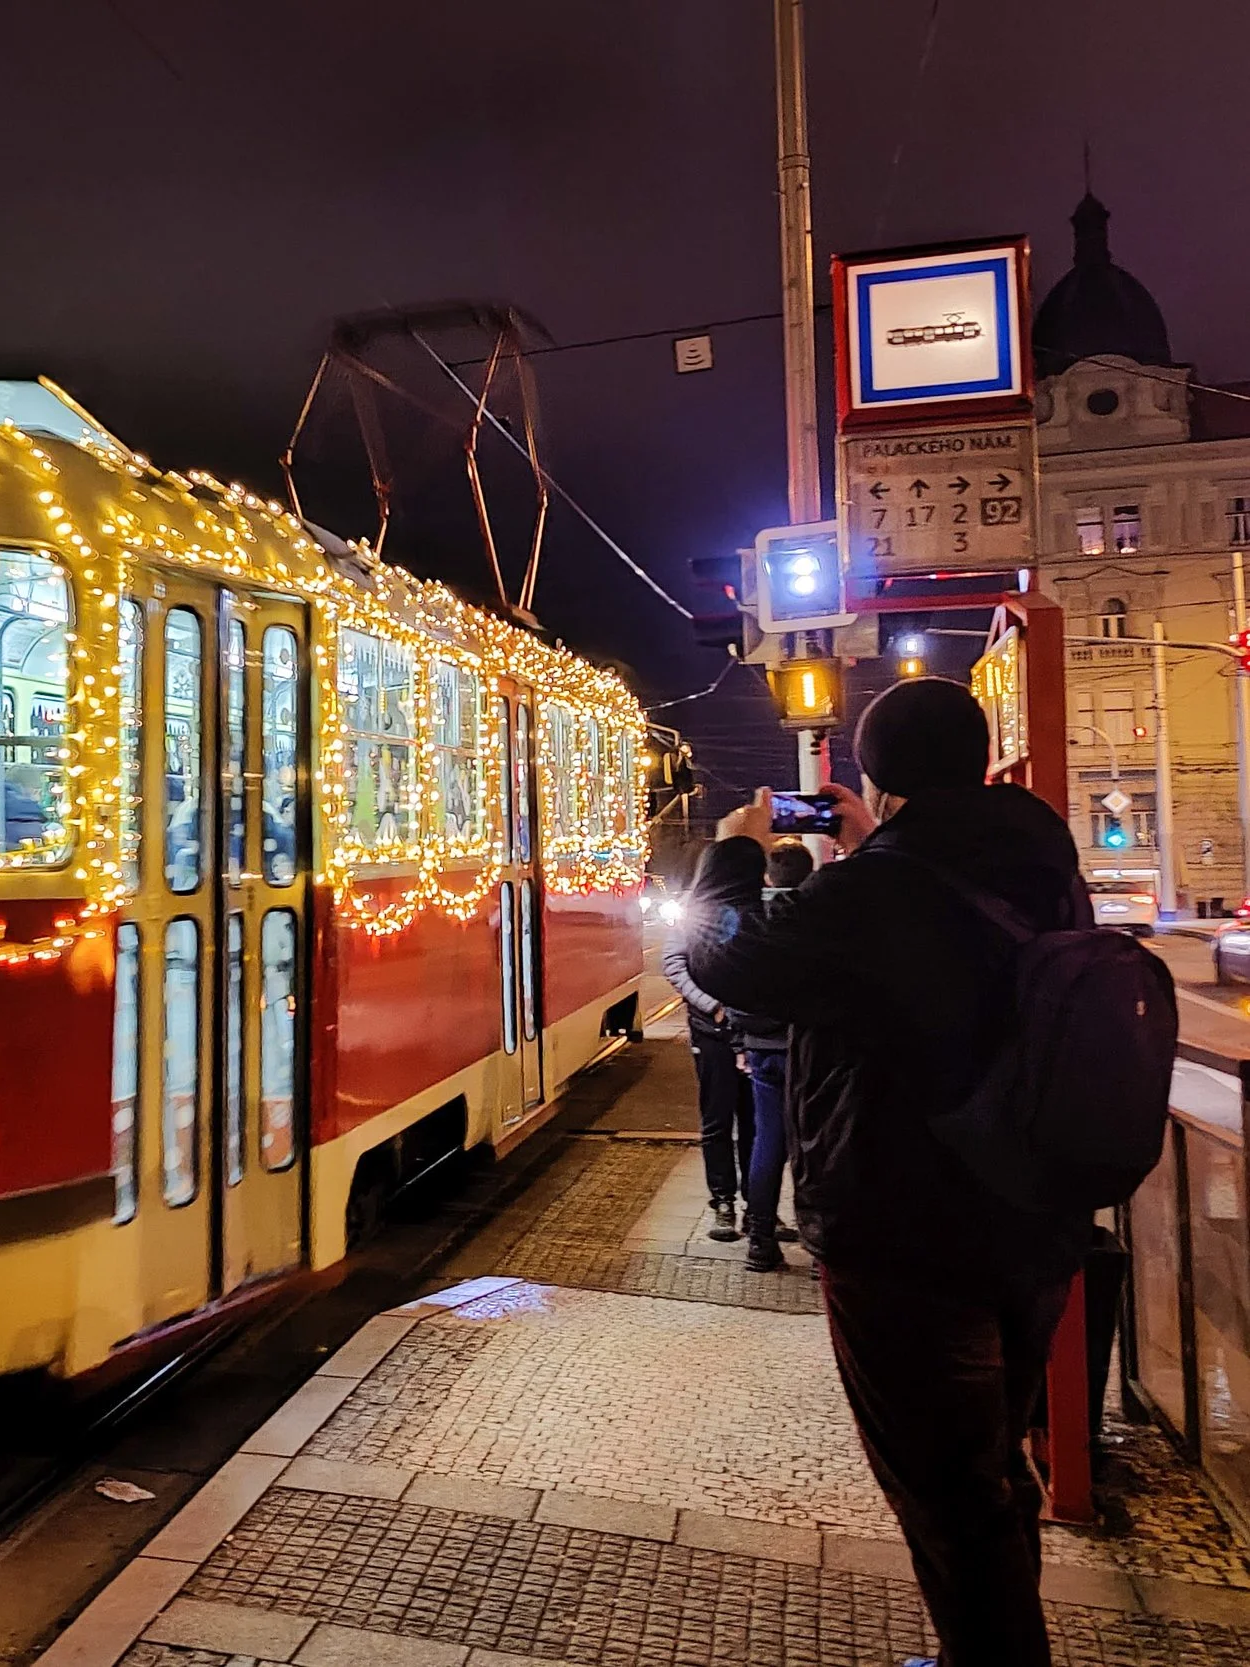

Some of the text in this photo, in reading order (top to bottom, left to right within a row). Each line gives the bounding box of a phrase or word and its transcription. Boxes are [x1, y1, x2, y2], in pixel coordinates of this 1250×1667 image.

[872, 500, 1019, 529] 7 17 2 92
[866, 532, 968, 557] 21 3
